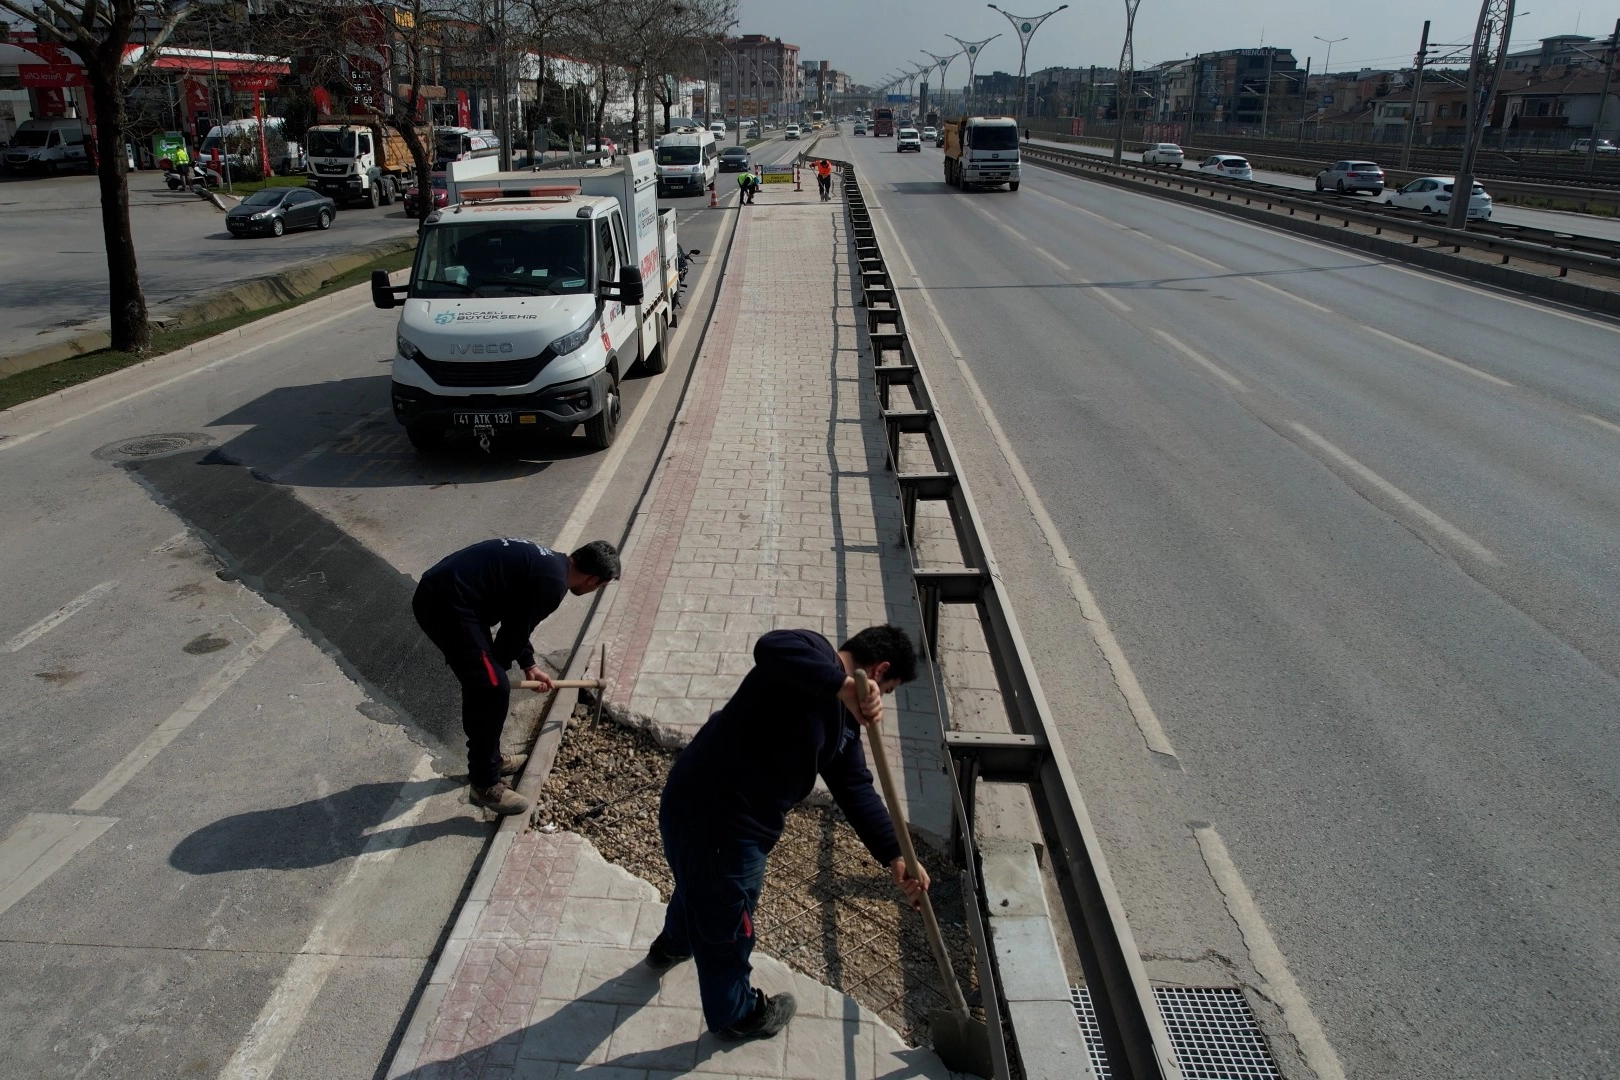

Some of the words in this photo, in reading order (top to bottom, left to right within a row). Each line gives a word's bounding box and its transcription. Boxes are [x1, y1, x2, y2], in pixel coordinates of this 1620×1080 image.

[450, 343, 514, 355] IVECO
[459, 414, 469, 425] 41
[474, 414, 491, 425] ATK
[494, 414, 510, 425] 132
